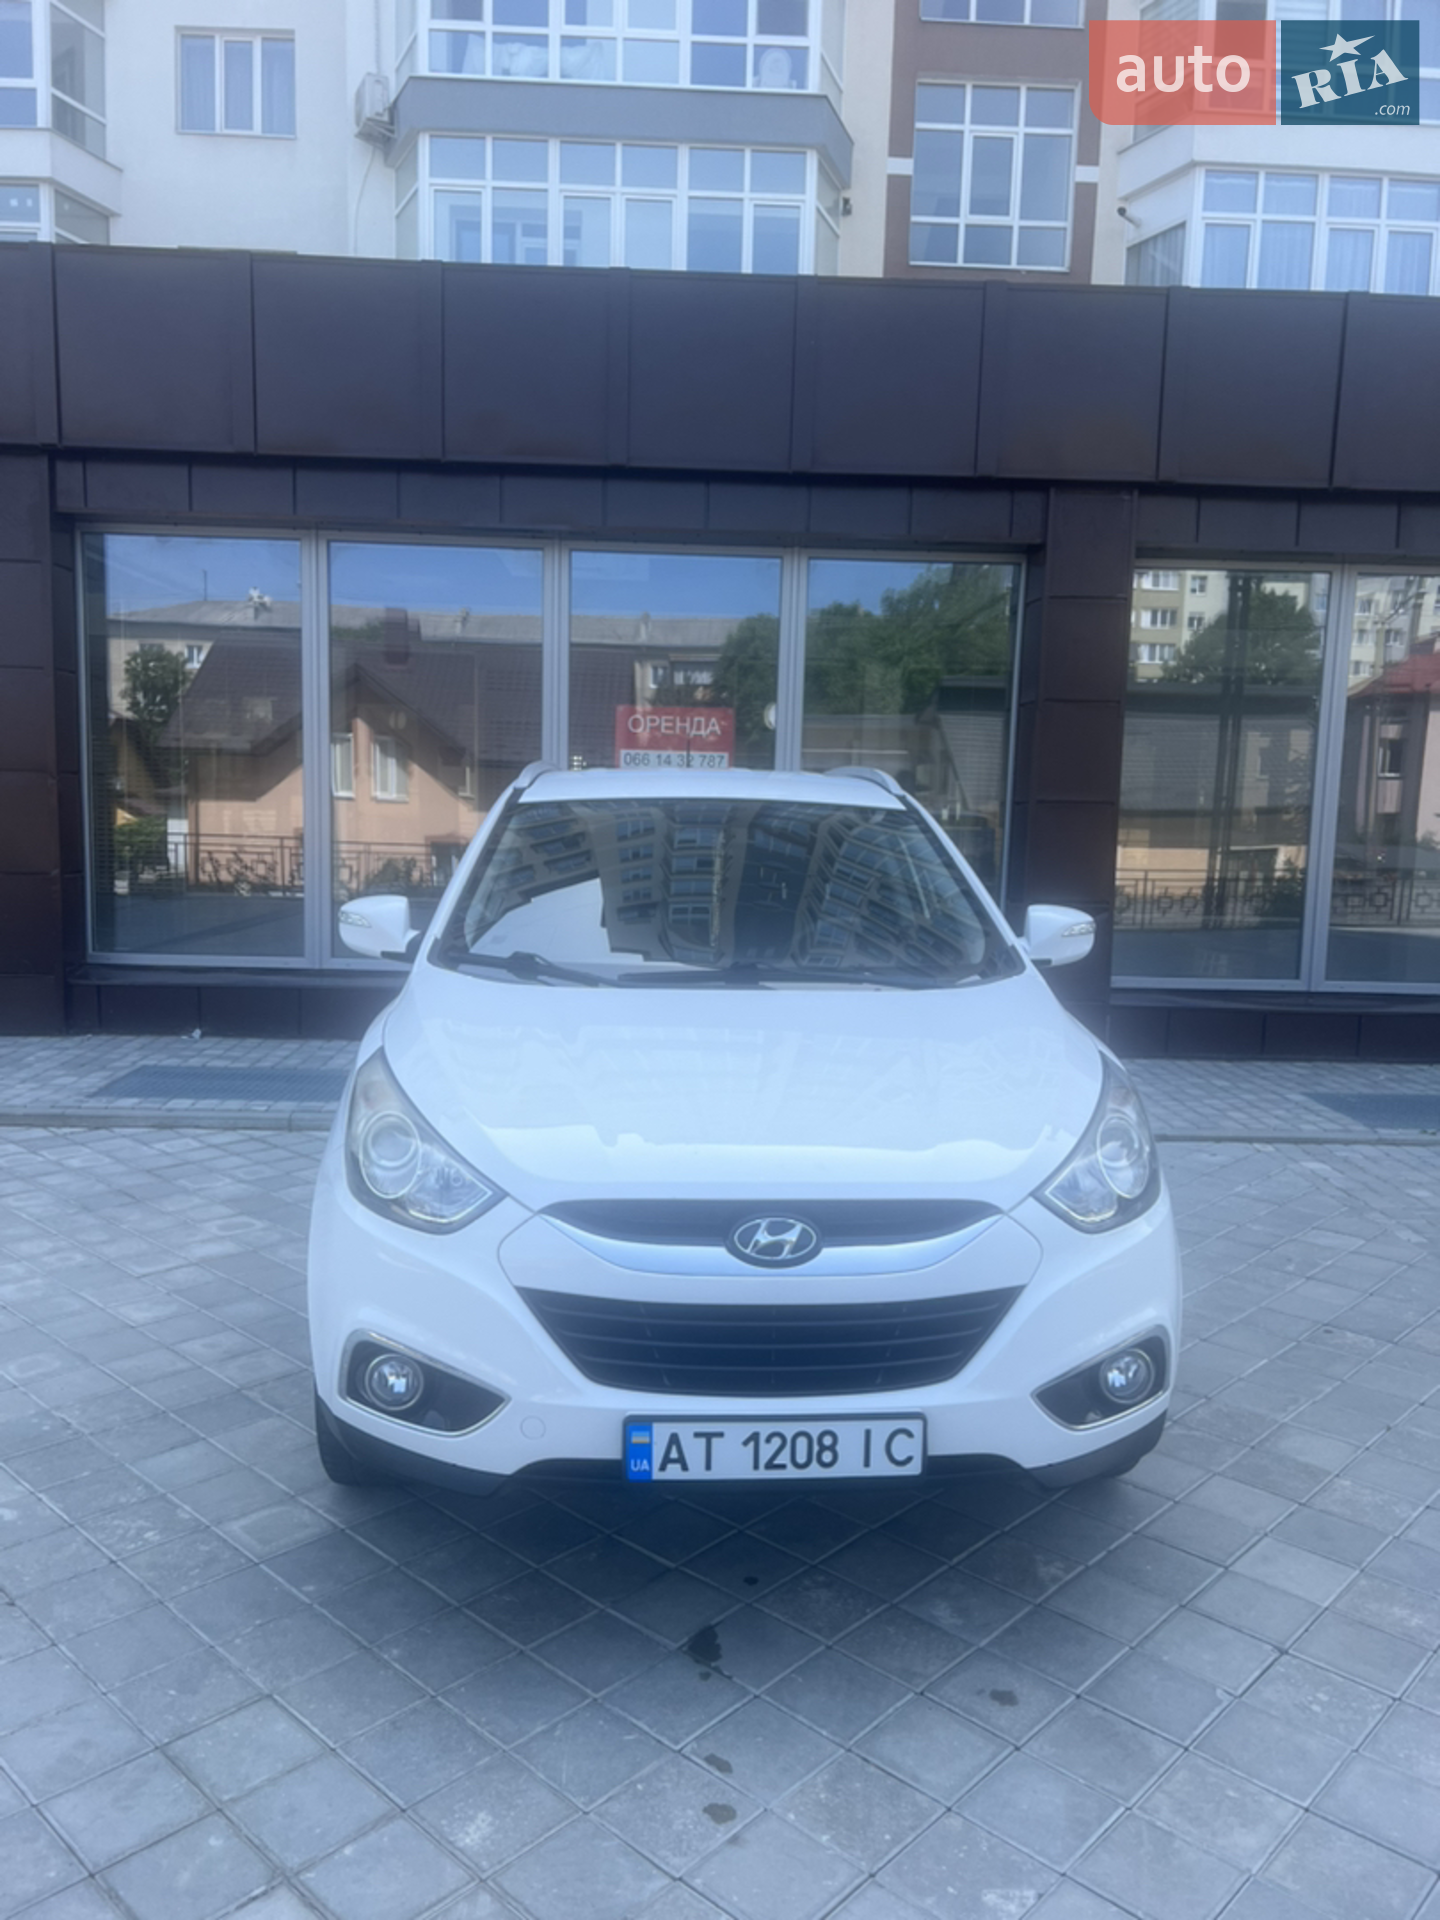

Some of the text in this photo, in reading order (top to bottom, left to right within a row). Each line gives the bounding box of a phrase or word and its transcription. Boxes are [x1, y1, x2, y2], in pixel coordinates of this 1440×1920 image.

[627, 714, 721, 738] ОРЕНДА
[623, 752, 650, 766] 066
[656, 753, 672, 766] 14
[698, 755, 725, 768] 787
[658, 1428, 915, 1471] AT 1208 IC
[631, 1459, 650, 1472] UA
